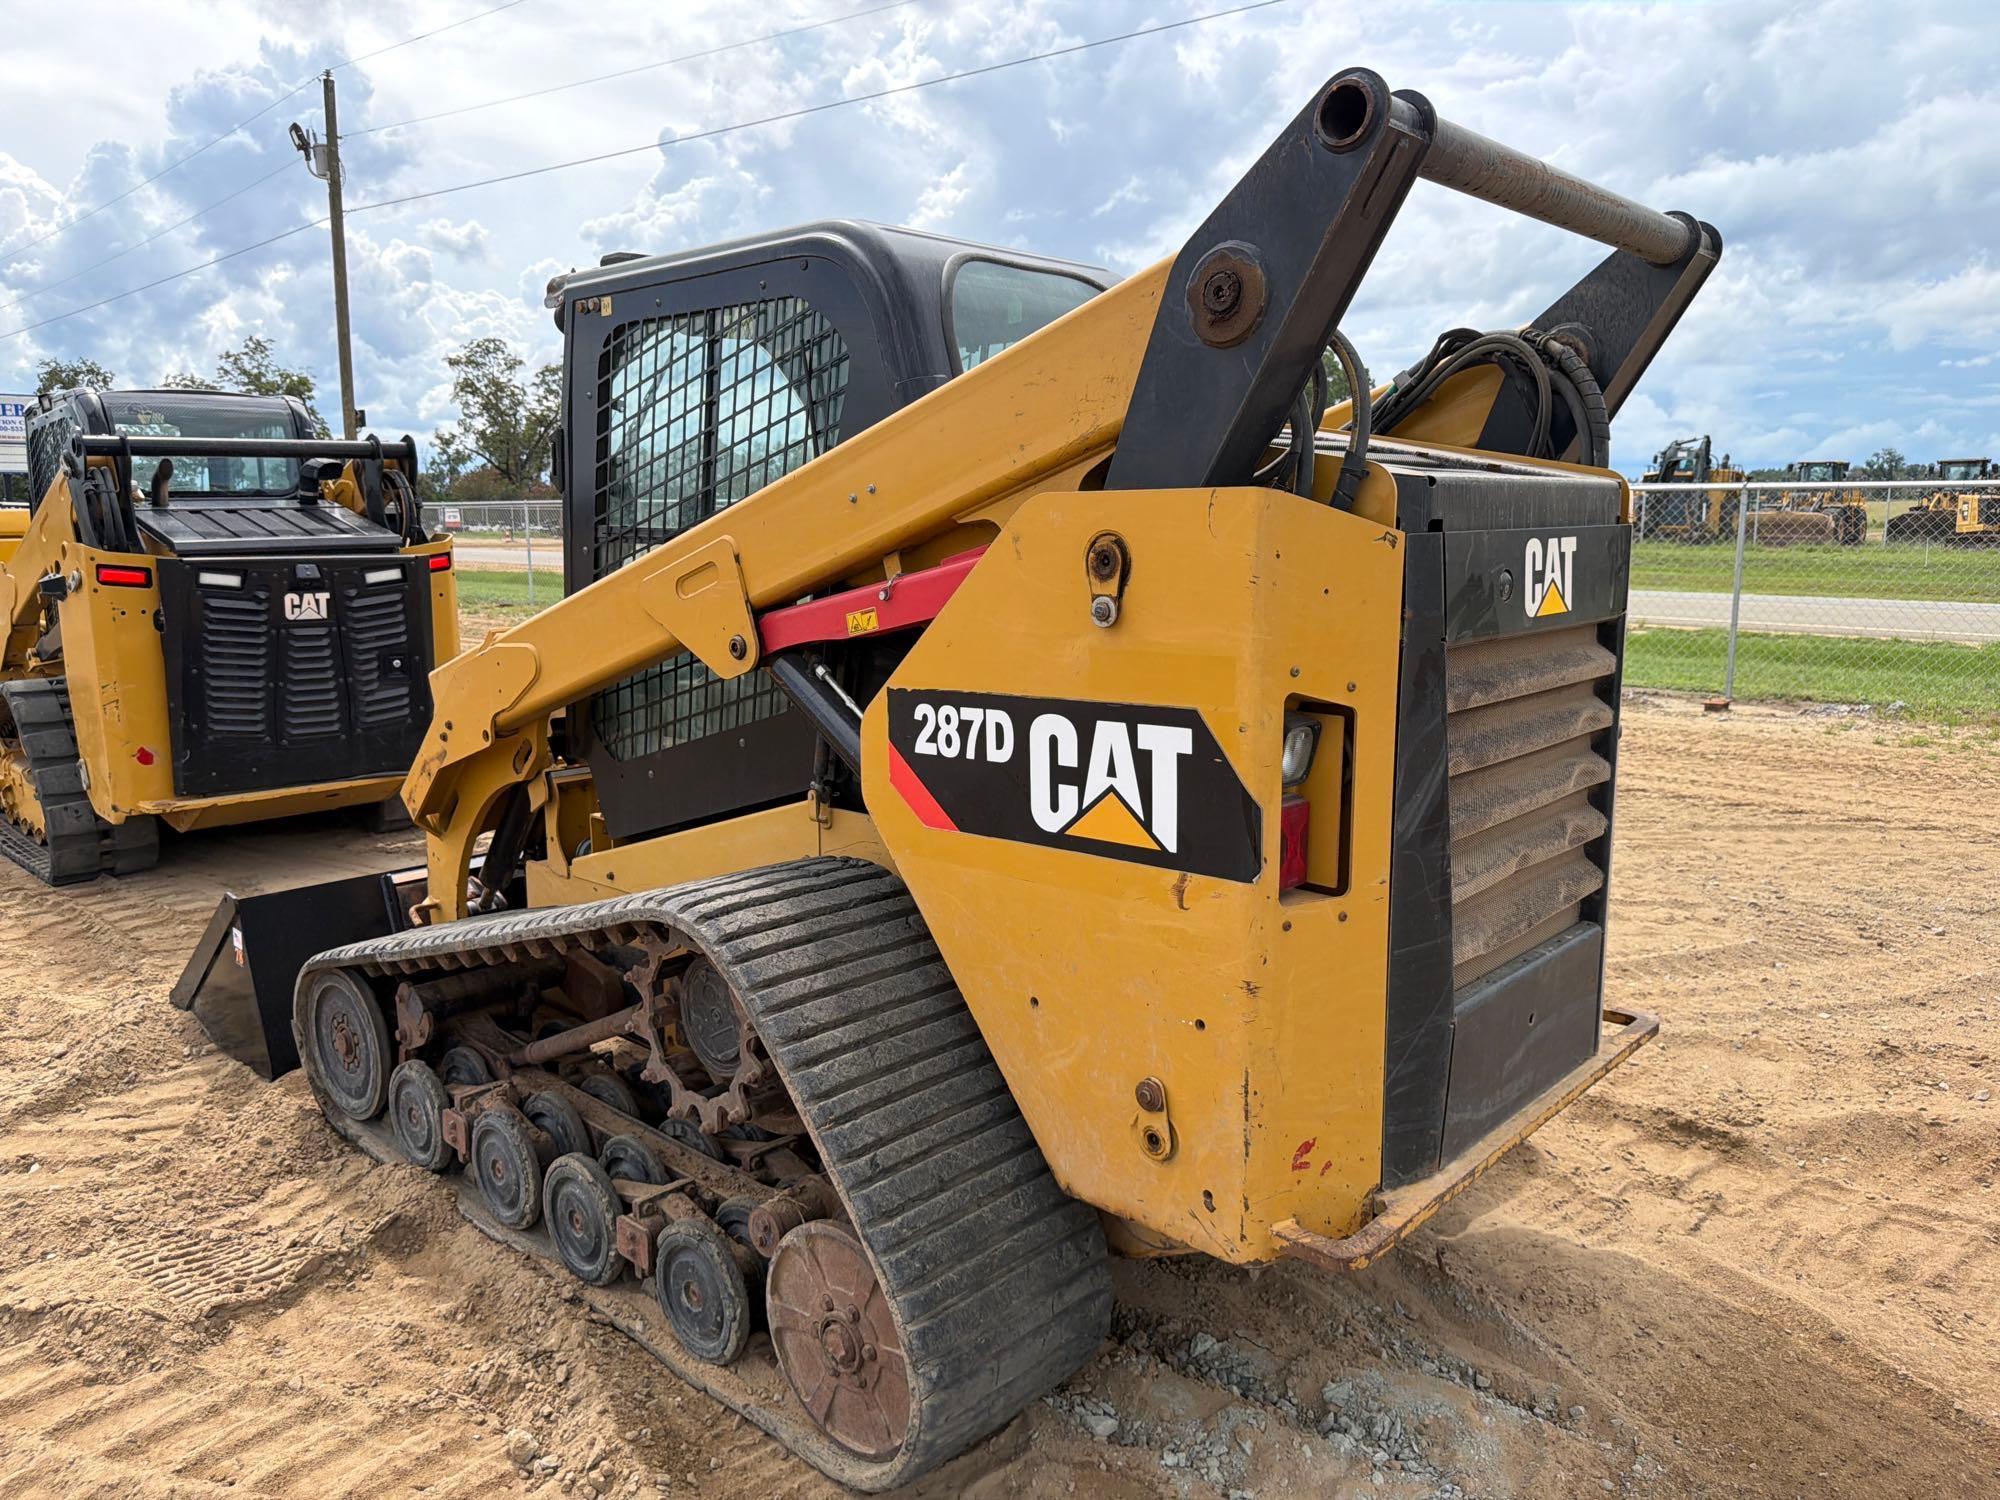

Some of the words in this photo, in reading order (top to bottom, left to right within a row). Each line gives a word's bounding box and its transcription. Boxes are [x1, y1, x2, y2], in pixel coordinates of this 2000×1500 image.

[0, 404, 25, 417] ER
[1525, 536, 1577, 617] CAT
[284, 592, 330, 620] CAT
[913, 703, 1015, 763] 287D
[1029, 713, 1193, 853] CAT
